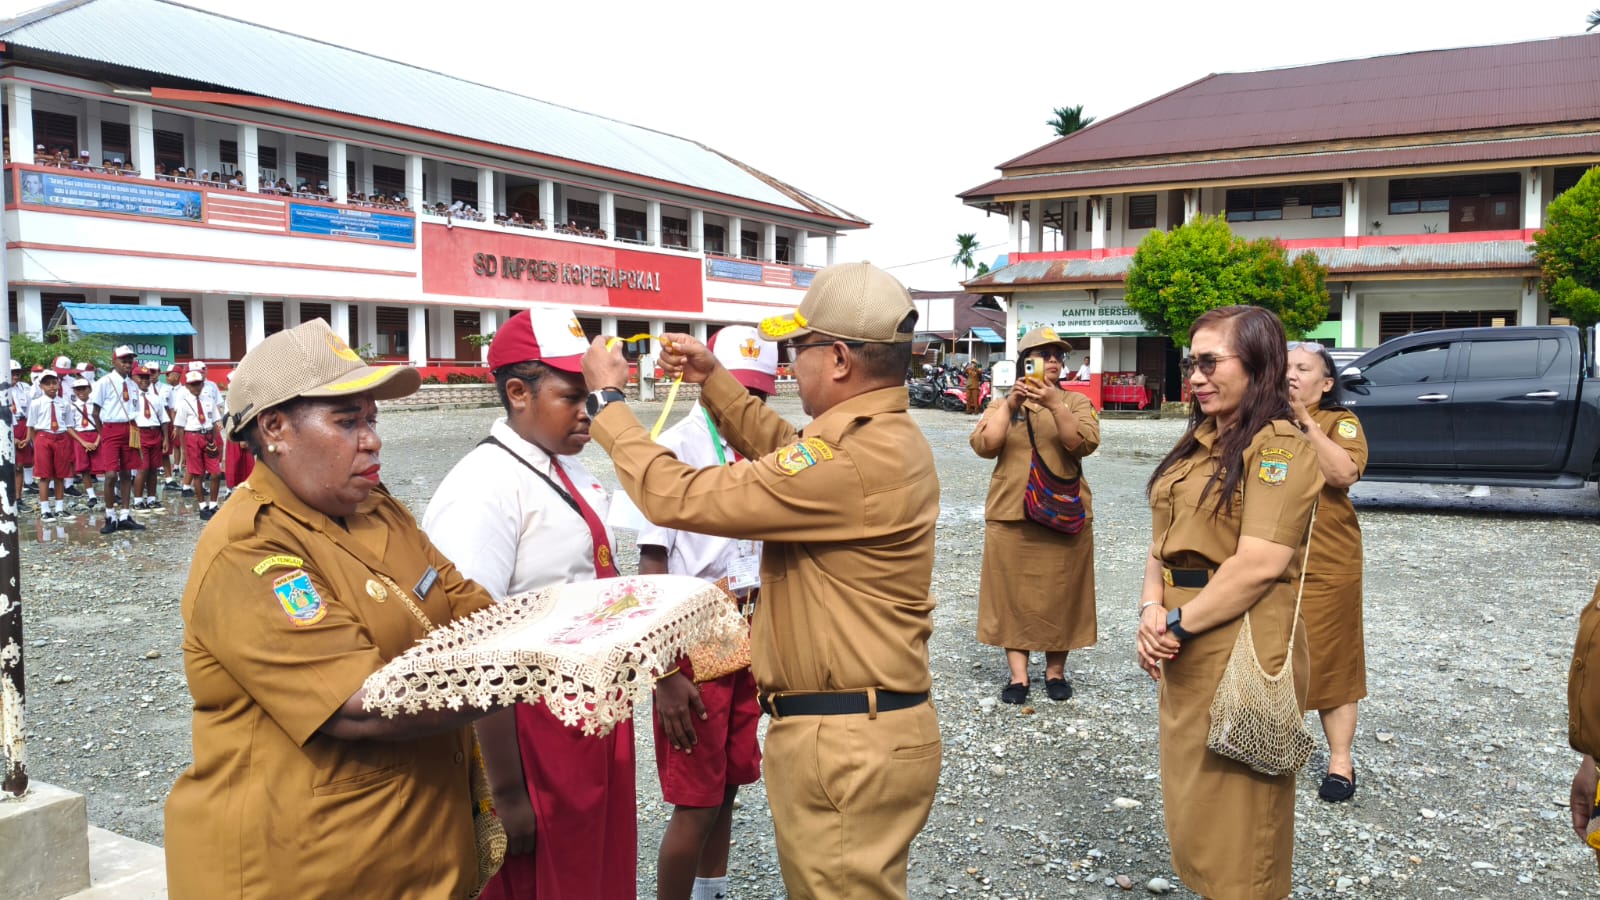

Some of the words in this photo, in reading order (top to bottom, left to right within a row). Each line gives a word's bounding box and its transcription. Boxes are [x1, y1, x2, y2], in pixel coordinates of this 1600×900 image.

[474, 253, 498, 277] SD
[501, 256, 558, 282] INPRES
[1062, 309, 1096, 317] KANTIN
[137, 343, 167, 356] BAWA
